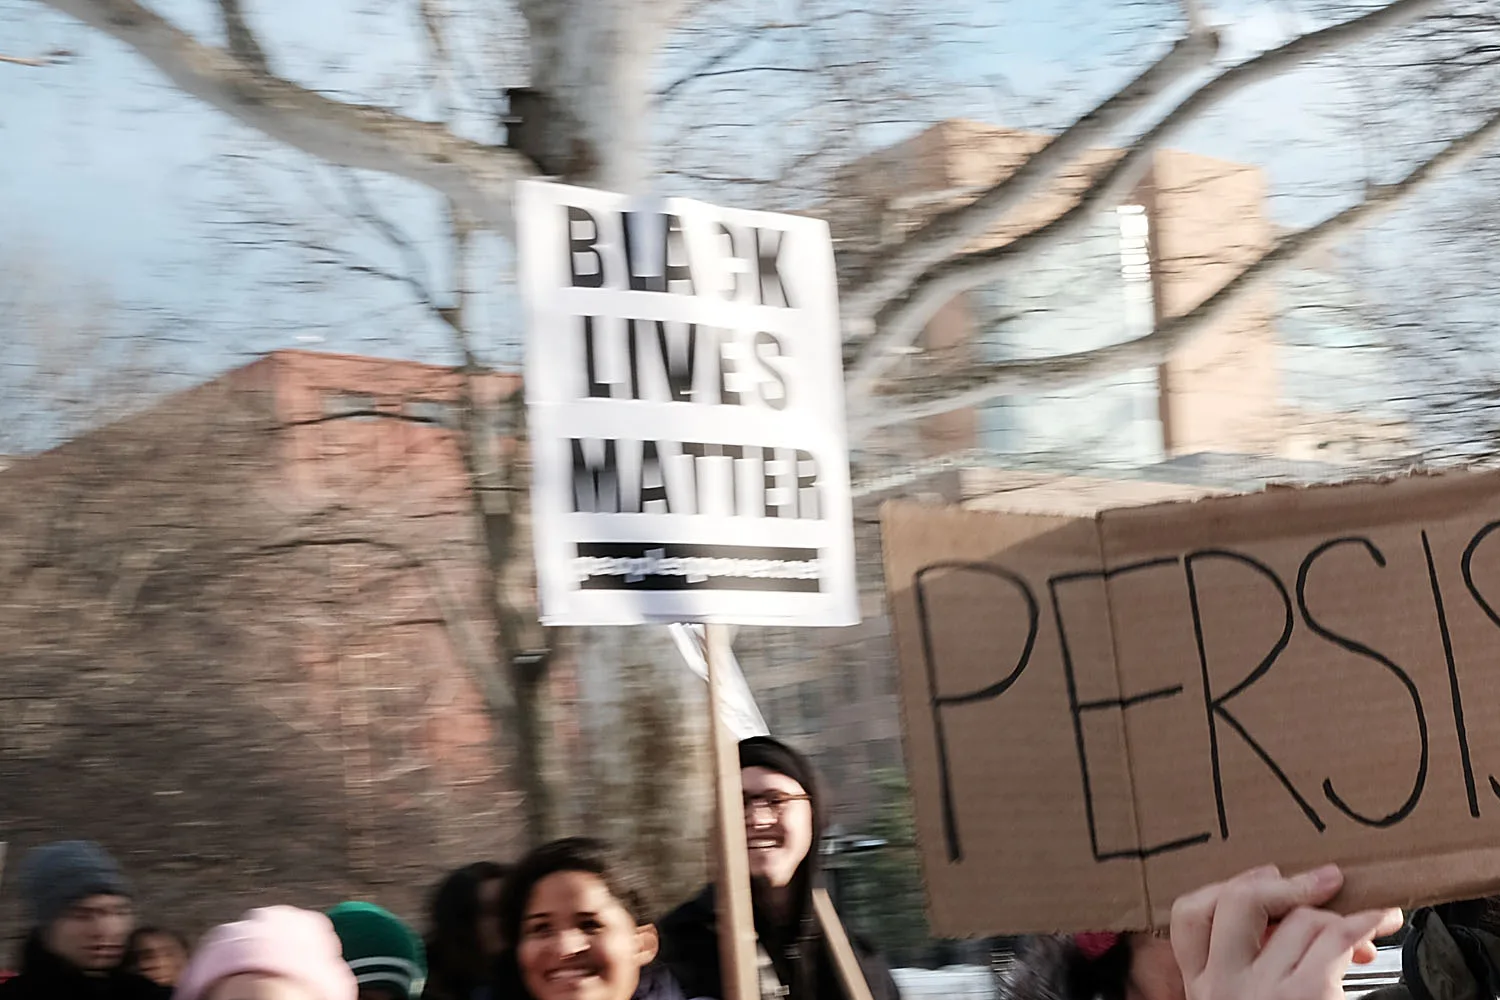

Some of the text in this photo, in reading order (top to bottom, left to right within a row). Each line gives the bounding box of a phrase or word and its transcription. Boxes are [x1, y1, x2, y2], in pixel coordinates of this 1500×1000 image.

[565, 204, 796, 309] BLACK
[580, 314, 789, 411] LIVES
[569, 438, 824, 521] MATTER
